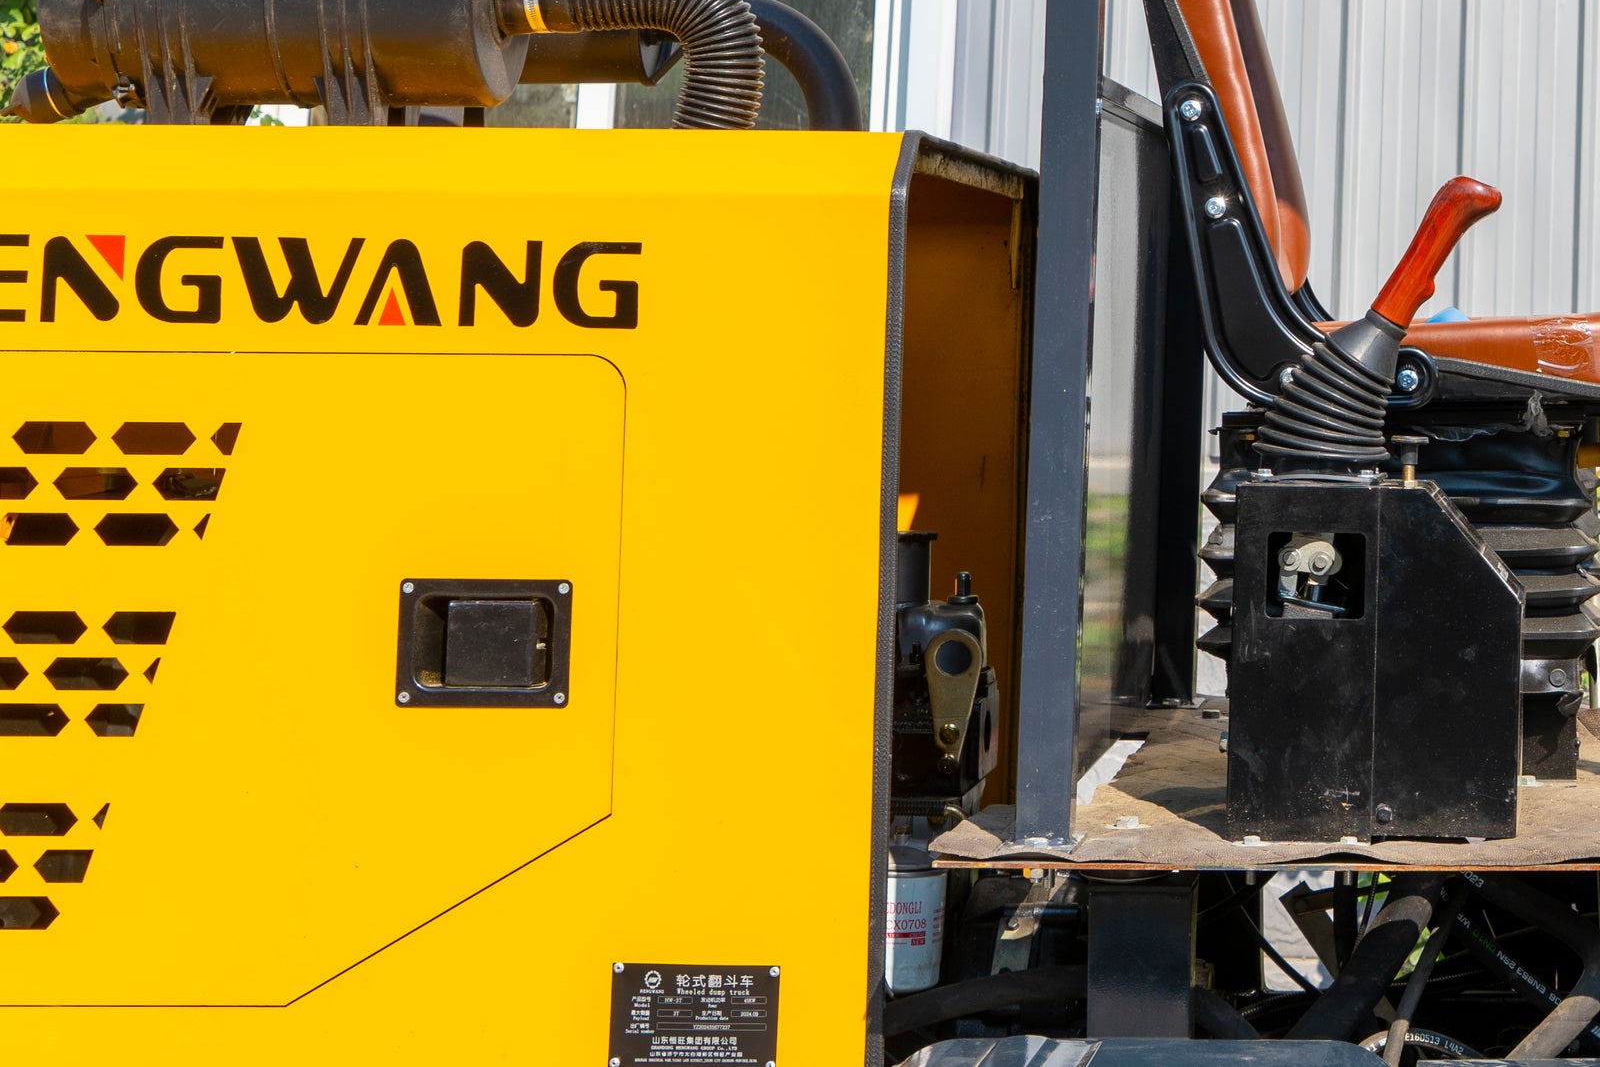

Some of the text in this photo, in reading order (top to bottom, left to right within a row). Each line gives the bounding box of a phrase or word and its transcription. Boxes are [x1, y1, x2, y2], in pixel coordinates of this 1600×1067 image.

[676, 974, 754, 988] 轮式翻斗车
[652, 1037, 737, 1045] 山东恒旺集团有限公司
